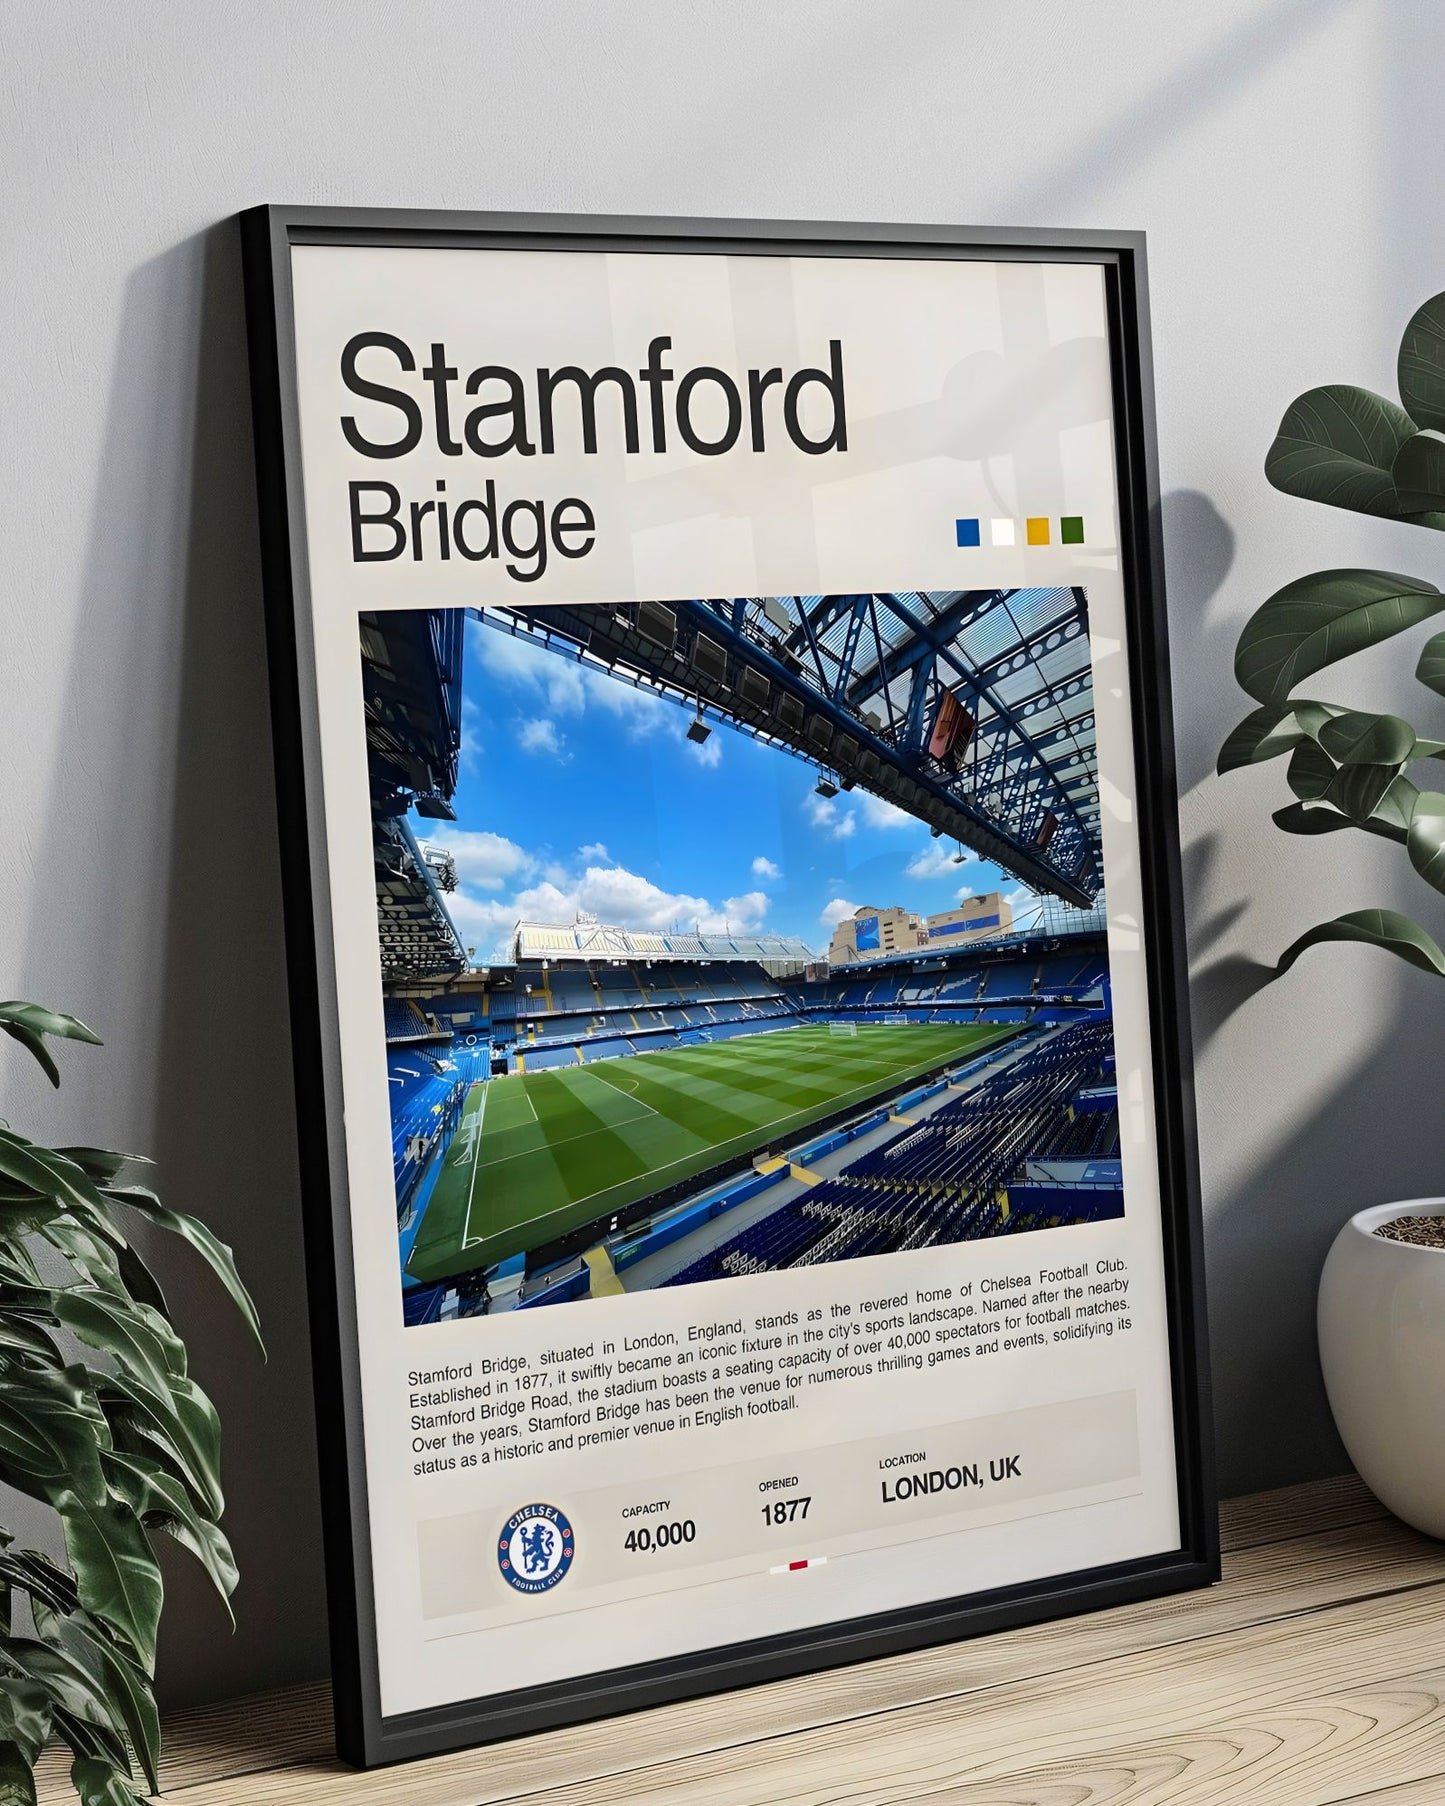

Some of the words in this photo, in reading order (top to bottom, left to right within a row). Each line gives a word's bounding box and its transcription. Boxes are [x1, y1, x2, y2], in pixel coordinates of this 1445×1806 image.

[340, 331, 848, 460] Stamford
[348, 479, 596, 583] Bridge
[408, 1362, 472, 1387] Stamford
[481, 1356, 531, 1375] Bridge,
[540, 1342, 594, 1366] situated
[602, 1340, 615, 1355] in
[624, 1332, 679, 1352] London,
[688, 1318, 746, 1342] England,
[755, 1311, 799, 1330] stands
[807, 1309, 822, 1322] as
[830, 1303, 851, 1318] the
[859, 1292, 908, 1314] revered
[916, 1288, 952, 1304] home
[960, 1281, 973, 1297] of
[980, 1275, 1032, 1293] Chelsea
[1039, 1263, 1089, 1284] Football
[1096, 1257, 1128, 1274] Club.
[409, 1380, 491, 1409] Established
[496, 1379, 509, 1394] in
[514, 1372, 552, 1391] 1877,
[557, 1370, 566, 1384] it
[571, 1362, 613, 1383] swiftly
[617, 1355, 672, 1374] became
[677, 1351, 694, 1365] an
[698, 1342, 737, 1361] iconic
[741, 1336, 782, 1353] fixture
[787, 1332, 799, 1346] in
[803, 1328, 824, 1343] the
[828, 1322, 861, 1340] city's
[865, 1315, 905, 1335] sports
[908, 1305, 978, 1325] landscape.
[982, 1293, 1027, 1314] Named
[1031, 1289, 1060, 1306] after
[1063, 1286, 1084, 1300] the
[1087, 1278, 1129, 1296] nearby
[411, 1406, 475, 1431] Stamford
[480, 1400, 526, 1420] Bridge
[531, 1390, 572, 1411] Road,
[577, 1387, 599, 1403] the
[604, 1378, 658, 1399] stadium
[662, 1369, 707, 1389] boasts
[712, 1368, 721, 1380] a
[725, 1358, 773, 1378] seating
[778, 1348, 832, 1370] capacity
[836, 1342, 849, 1359] of
[853, 1341, 883, 1356] over
[887, 1329, 931, 1350] 40,000
[935, 1321, 1001, 1344] spectators
[1004, 1315, 1022, 1330] for
[1025, 1306, 1071, 1326] football
[1075, 1299, 1130, 1319] matches.
[412, 1436, 447, 1453] Over
[452, 1431, 475, 1446] the
[479, 1424, 522, 1446] years,
[528, 1408, 591, 1433] Stamford
[596, 1402, 640, 1422] Bridge
[645, 1398, 671, 1413] has
[675, 1391, 709, 1408] been
[713, 1385, 735, 1401] the
[739, 1379, 781, 1396] venue
[785, 1374, 803, 1389] for
[808, 1363, 873, 1385] numerous
[877, 1354, 923, 1373] thrilling
[927, 1346, 971, 1367] games
[975, 1338, 999, 1356] and
[1003, 1332, 1048, 1351] events,
[1053, 1321, 1113, 1342] solidifying
[1117, 1316, 1132, 1331] its
[413, 1457, 456, 1476] status
[460, 1454, 478, 1468] as
[481, 1452, 491, 1464] a
[494, 1440, 544, 1462] historic
[548, 1433, 574, 1452] and
[578, 1426, 630, 1451] premier
[633, 1419, 675, 1436] venue
[678, 1414, 691, 1429] in
[695, 1404, 743, 1427] English
[747, 1394, 799, 1416] football.
[758, 1475, 799, 1492] OPENED
[879, 1451, 926, 1470] LOCATION
[881, 1464, 984, 1503] LONDON,
[989, 1454, 1022, 1482] UK
[508, 1506, 559, 1529] CHELSEA
[621, 1500, 671, 1519] CAPACITY
[761, 1496, 812, 1527] 1877
[624, 1519, 696, 1554] 40,000
[511, 1577, 546, 1591] FOOTBALL
[548, 1568, 564, 1585] CLUB
